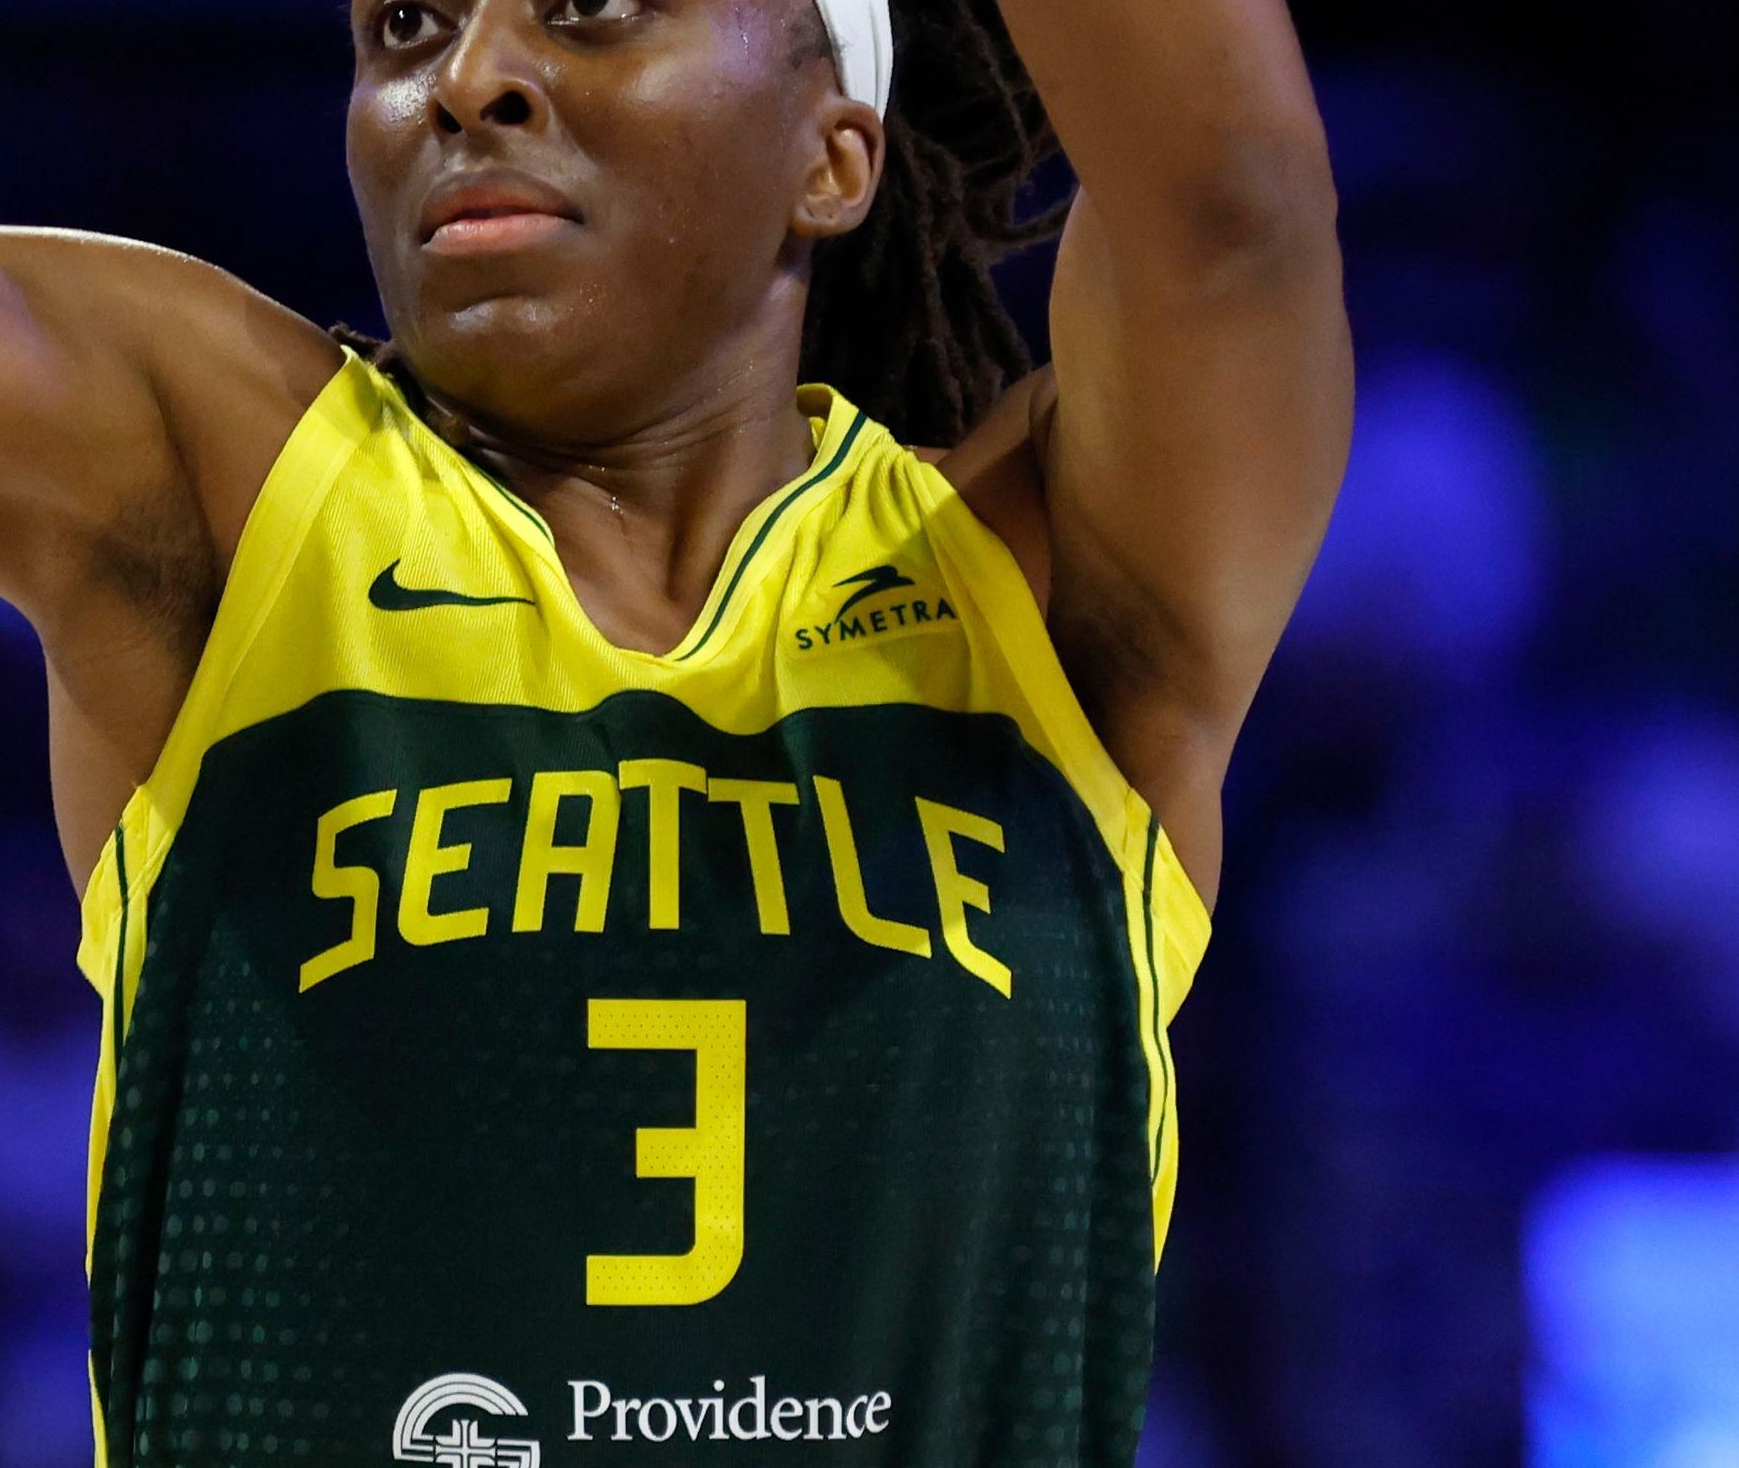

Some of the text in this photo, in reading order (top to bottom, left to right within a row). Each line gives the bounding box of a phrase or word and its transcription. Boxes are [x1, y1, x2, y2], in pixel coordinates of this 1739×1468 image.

[794, 597, 958, 651] SYMETRA
[299, 758, 1012, 1000] SEATTLE
[586, 998, 746, 1306] 3
[566, 1375, 893, 1442] Providence
